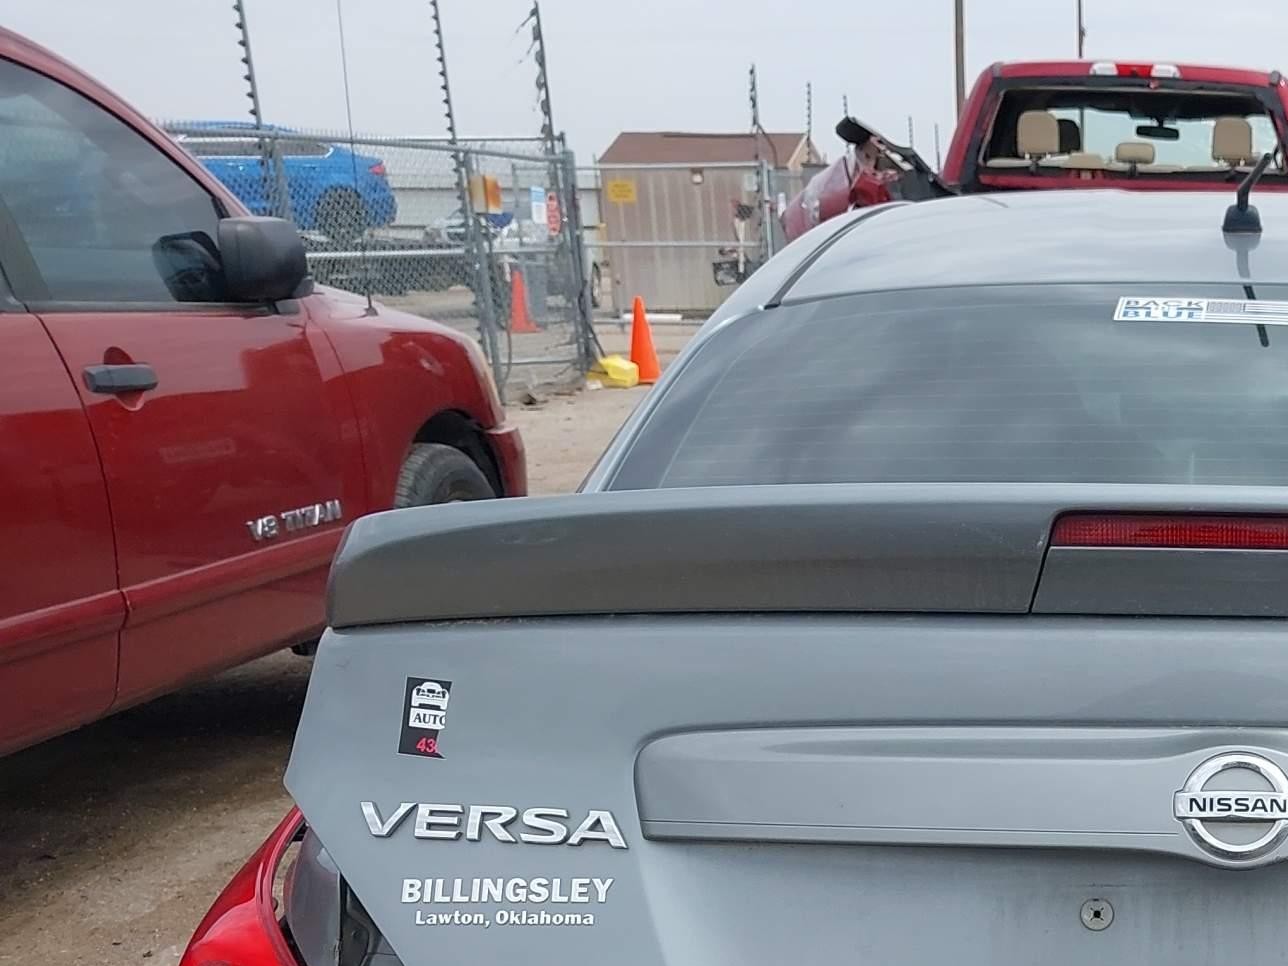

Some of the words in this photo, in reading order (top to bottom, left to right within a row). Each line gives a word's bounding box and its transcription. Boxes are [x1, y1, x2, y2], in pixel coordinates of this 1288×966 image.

[245, 515, 278, 540] V8
[281, 499, 342, 531] TITAN
[1189, 797, 1286, 813] NISSAN
[360, 801, 628, 849] VERSA
[401, 877, 615, 904] BILLINGSLEY
[415, 910, 491, 928] Lawton,
[495, 909, 595, 926] Oklahoma
